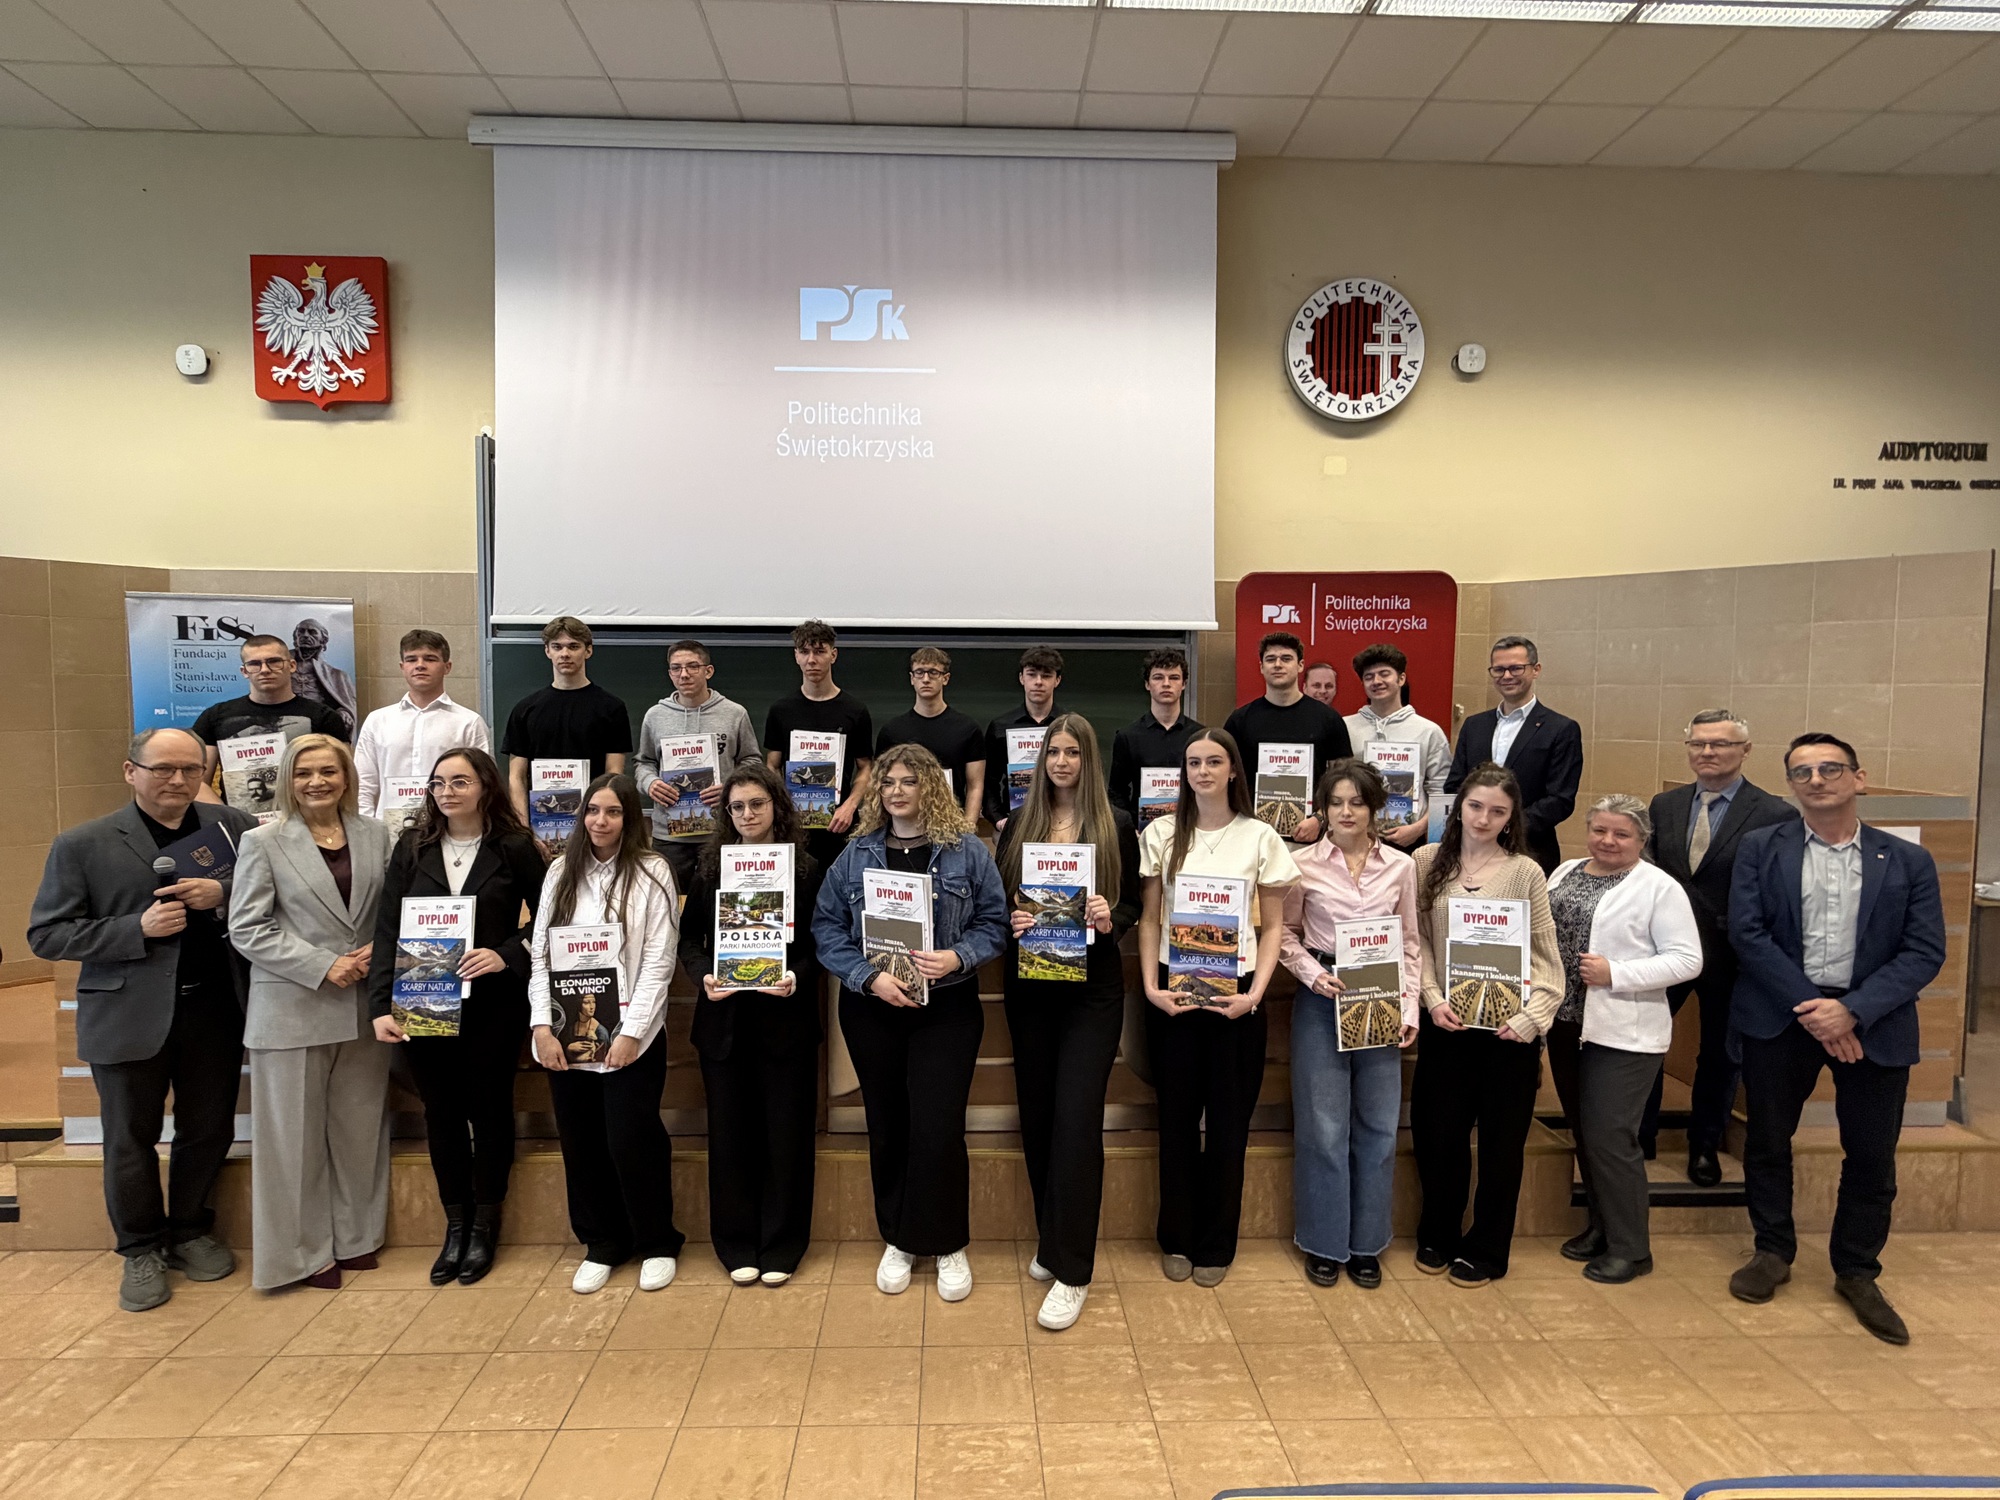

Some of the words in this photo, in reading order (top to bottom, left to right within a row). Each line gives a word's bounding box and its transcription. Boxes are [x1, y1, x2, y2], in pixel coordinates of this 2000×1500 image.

[1295, 281, 1418, 334] POLITECHNIKA
[1293, 357, 1420, 416] ŚWIĘTOKRZYSKA
[788, 401, 922, 425] Politechnika
[776, 428, 934, 463] Świętokrzyska
[1878, 441, 1988, 462] AUDYTORIUM
[1325, 595, 1411, 610] Politechnika
[1325, 611, 1428, 634] Świętokrzyska
[174, 648, 227, 660] Fundacja
[174, 660, 193, 670] im.
[174, 672, 237, 682] Stanisława
[174, 682, 223, 694] Staszica
[672, 746, 704, 756] DYPLOM
[800, 742, 830, 751] DYPLOM
[236, 746, 275, 759] DYPLOM
[1377, 753, 1409, 762] DYPLOM
[1269, 755, 1300, 764] DYPLOM
[542, 771, 573, 779] DYPLOM
[538, 820, 555, 828] SKARBY
[735, 860, 775, 871] DYPLOM
[1037, 860, 1078, 871] DYPLOM
[876, 887, 913, 902] DYPLOM
[1189, 891, 1230, 904] DYPLOM
[418, 914, 458, 925] DYPLOM
[1463, 912, 1508, 926] DYPLOM
[720, 931, 782, 941] POLSKA
[1027, 927, 1051, 937] SKARBY
[1053, 928, 1080, 938] NATURY
[567, 940, 609, 953] DYPLOM
[1350, 934, 1388, 948] DYPLOM
[1179, 954, 1204, 965] SKARBY
[1206, 956, 1230, 966] POLSKI
[1473, 964, 1499, 973] muzea,
[1451, 968, 1485, 979] skanseny
[1490, 972, 1521, 983] kolekcje
[401, 982, 426, 992] SKARBY
[427, 982, 456, 991] NATURY
[554, 977, 611, 988] LEONARDO
[561, 987, 576, 996] DA
[577, 985, 605, 994] VINCI
